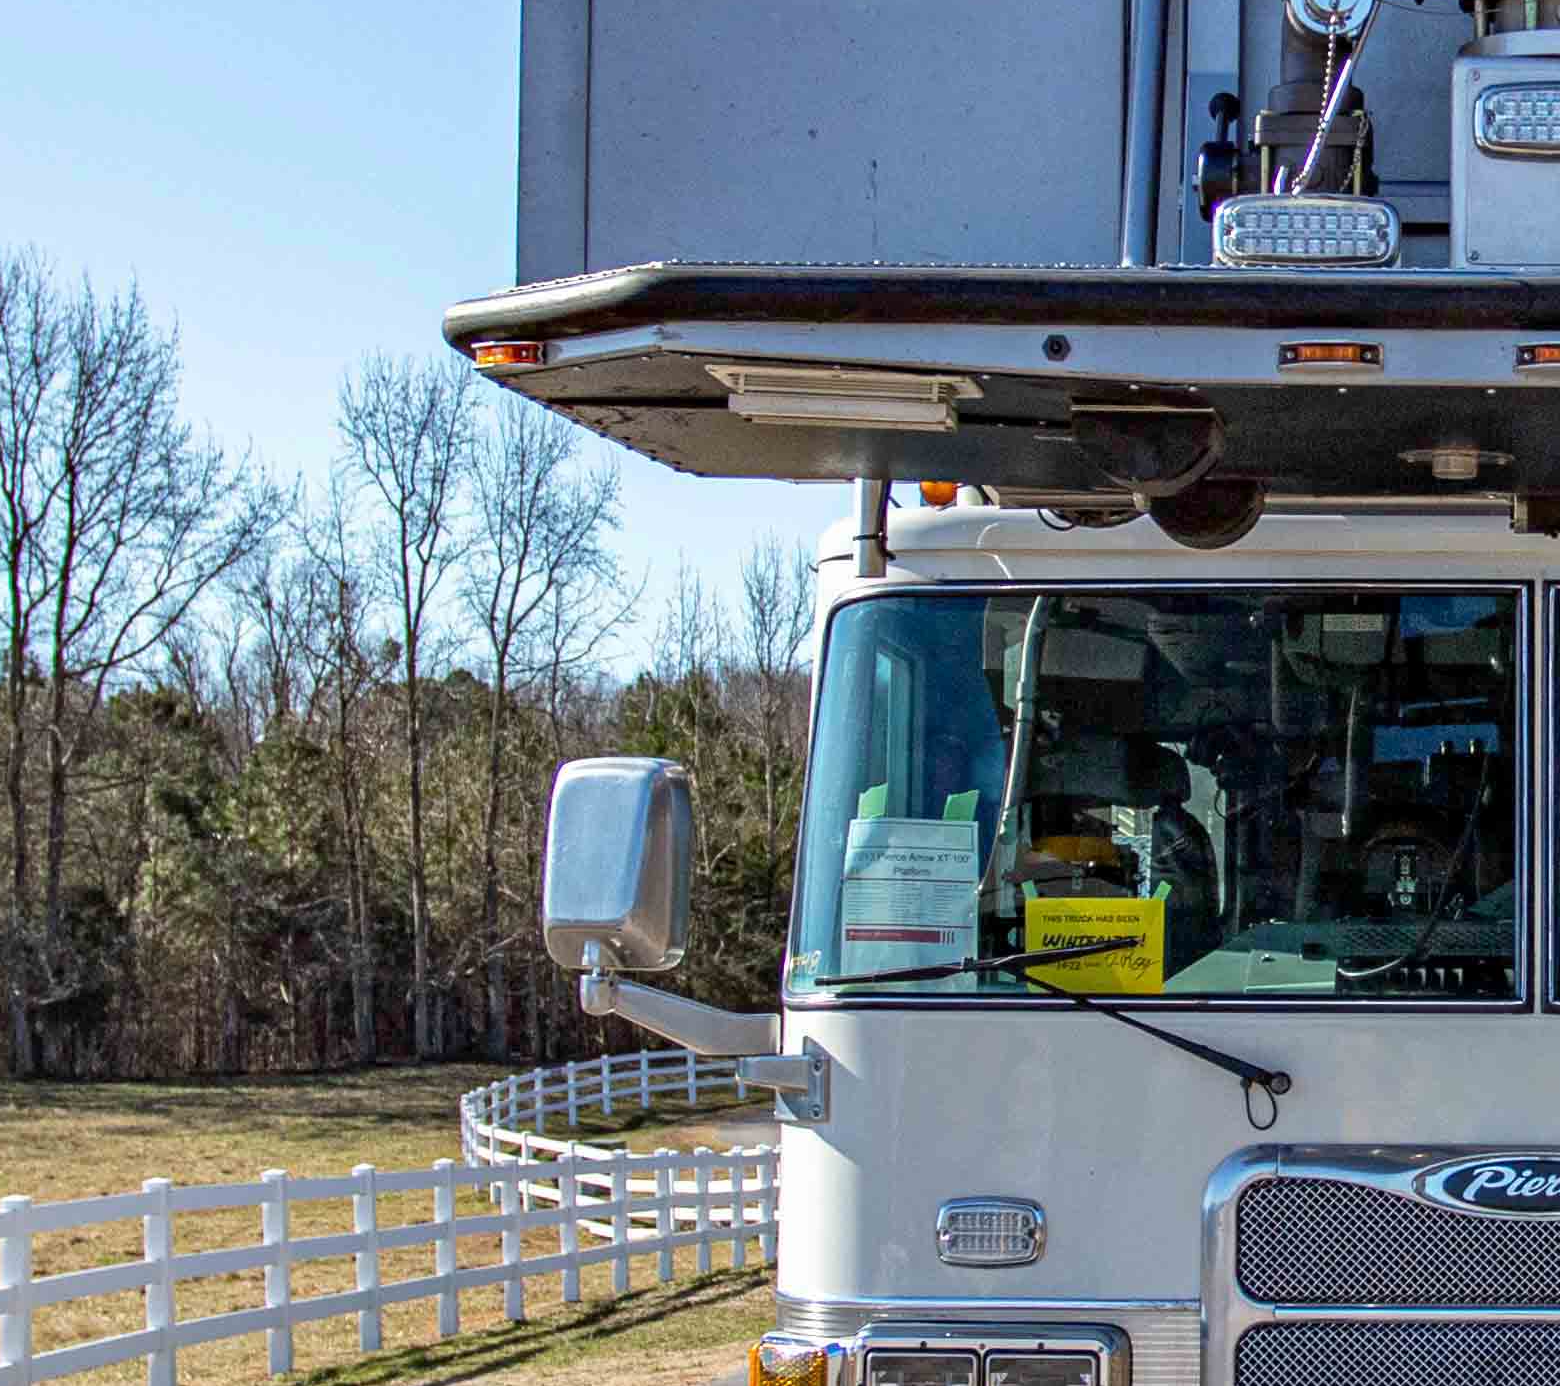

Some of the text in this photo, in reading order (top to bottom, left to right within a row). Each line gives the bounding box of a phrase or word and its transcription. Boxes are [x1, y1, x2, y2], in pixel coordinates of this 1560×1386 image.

[1042, 915, 1141, 924] THIS TRUCK HAS BEEN
